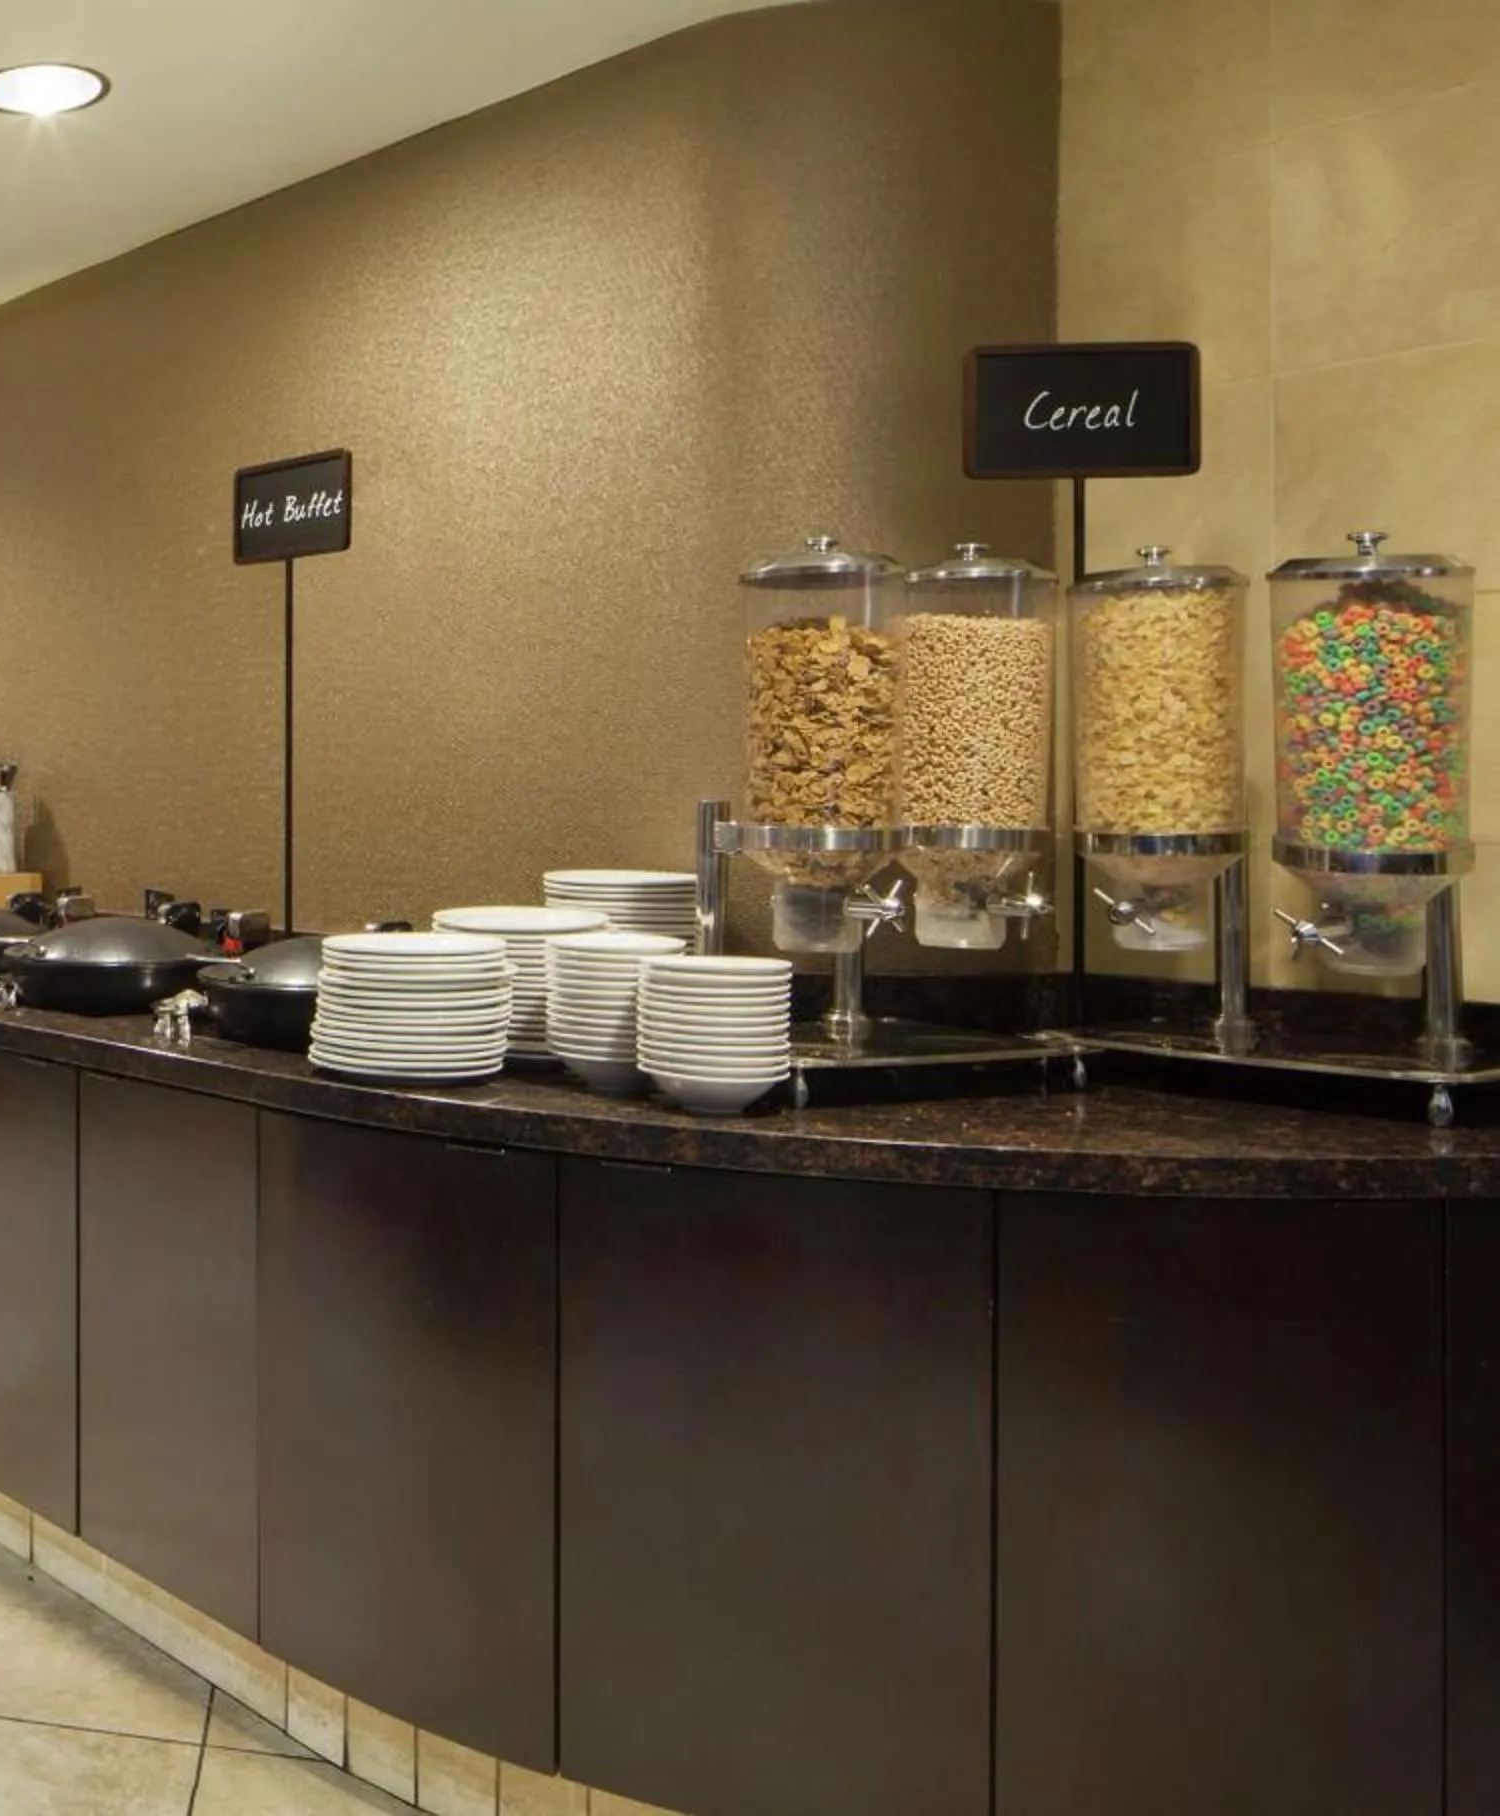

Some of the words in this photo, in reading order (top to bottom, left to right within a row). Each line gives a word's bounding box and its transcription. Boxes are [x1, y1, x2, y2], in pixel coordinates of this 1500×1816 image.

[1023, 388, 1140, 432] Cereal
[241, 499, 275, 529] Hot
[283, 488, 344, 523] Buffet
